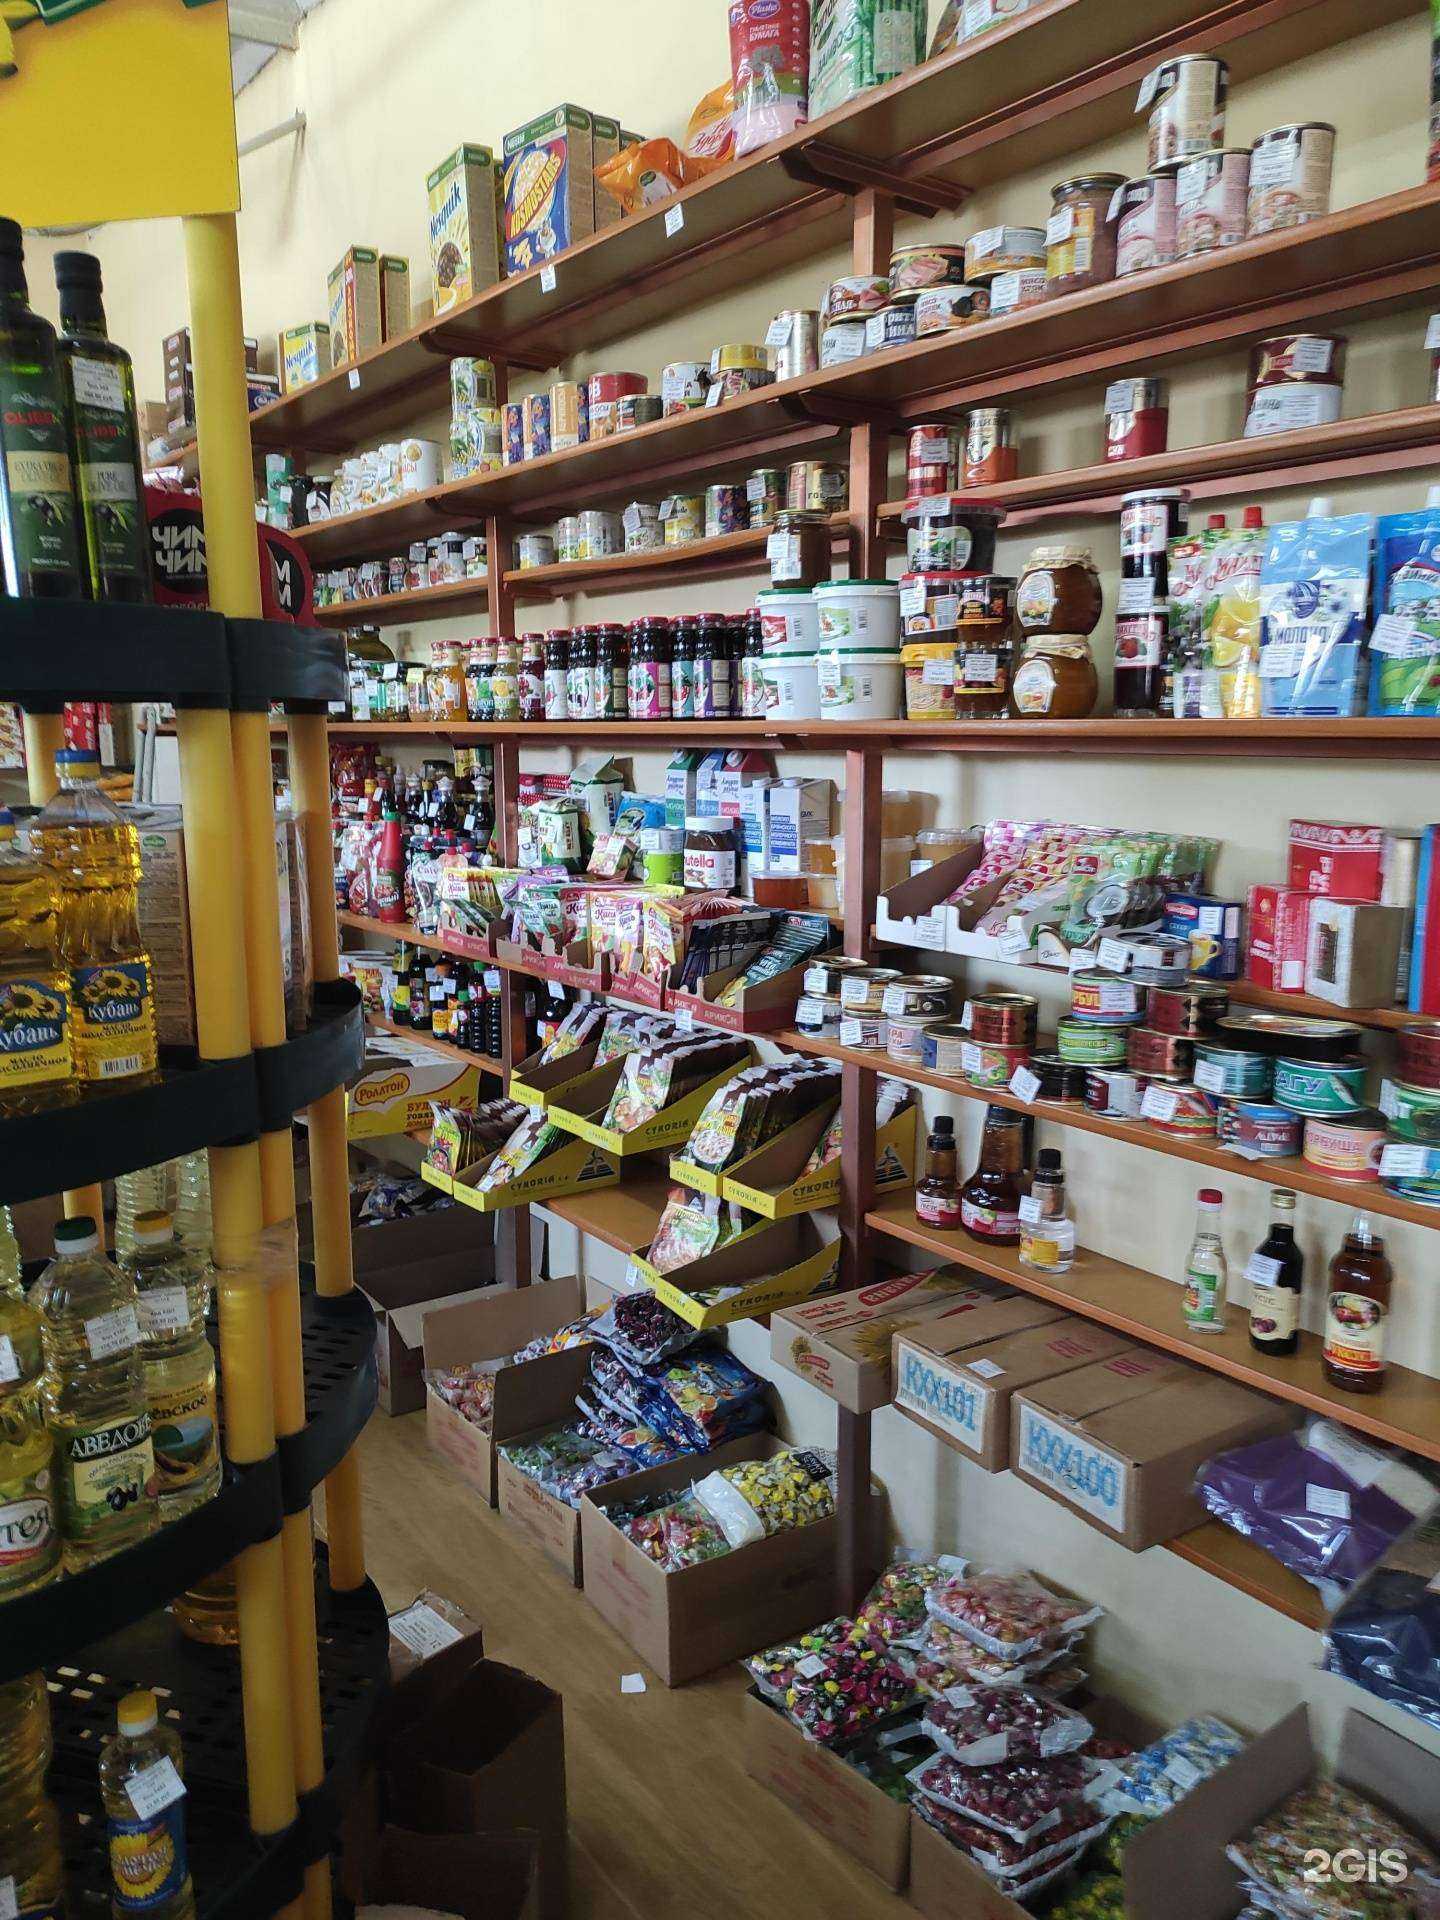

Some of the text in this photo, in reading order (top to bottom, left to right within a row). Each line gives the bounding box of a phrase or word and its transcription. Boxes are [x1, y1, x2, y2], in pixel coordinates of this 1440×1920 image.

[430, 181, 462, 244] Nesquik
[286, 339, 314, 368] Nesquik
[88, 1000, 140, 1022] Кубань
[645, 1119, 689, 1137] CYKORIA
[510, 1174, 555, 1191] CYKORIA
